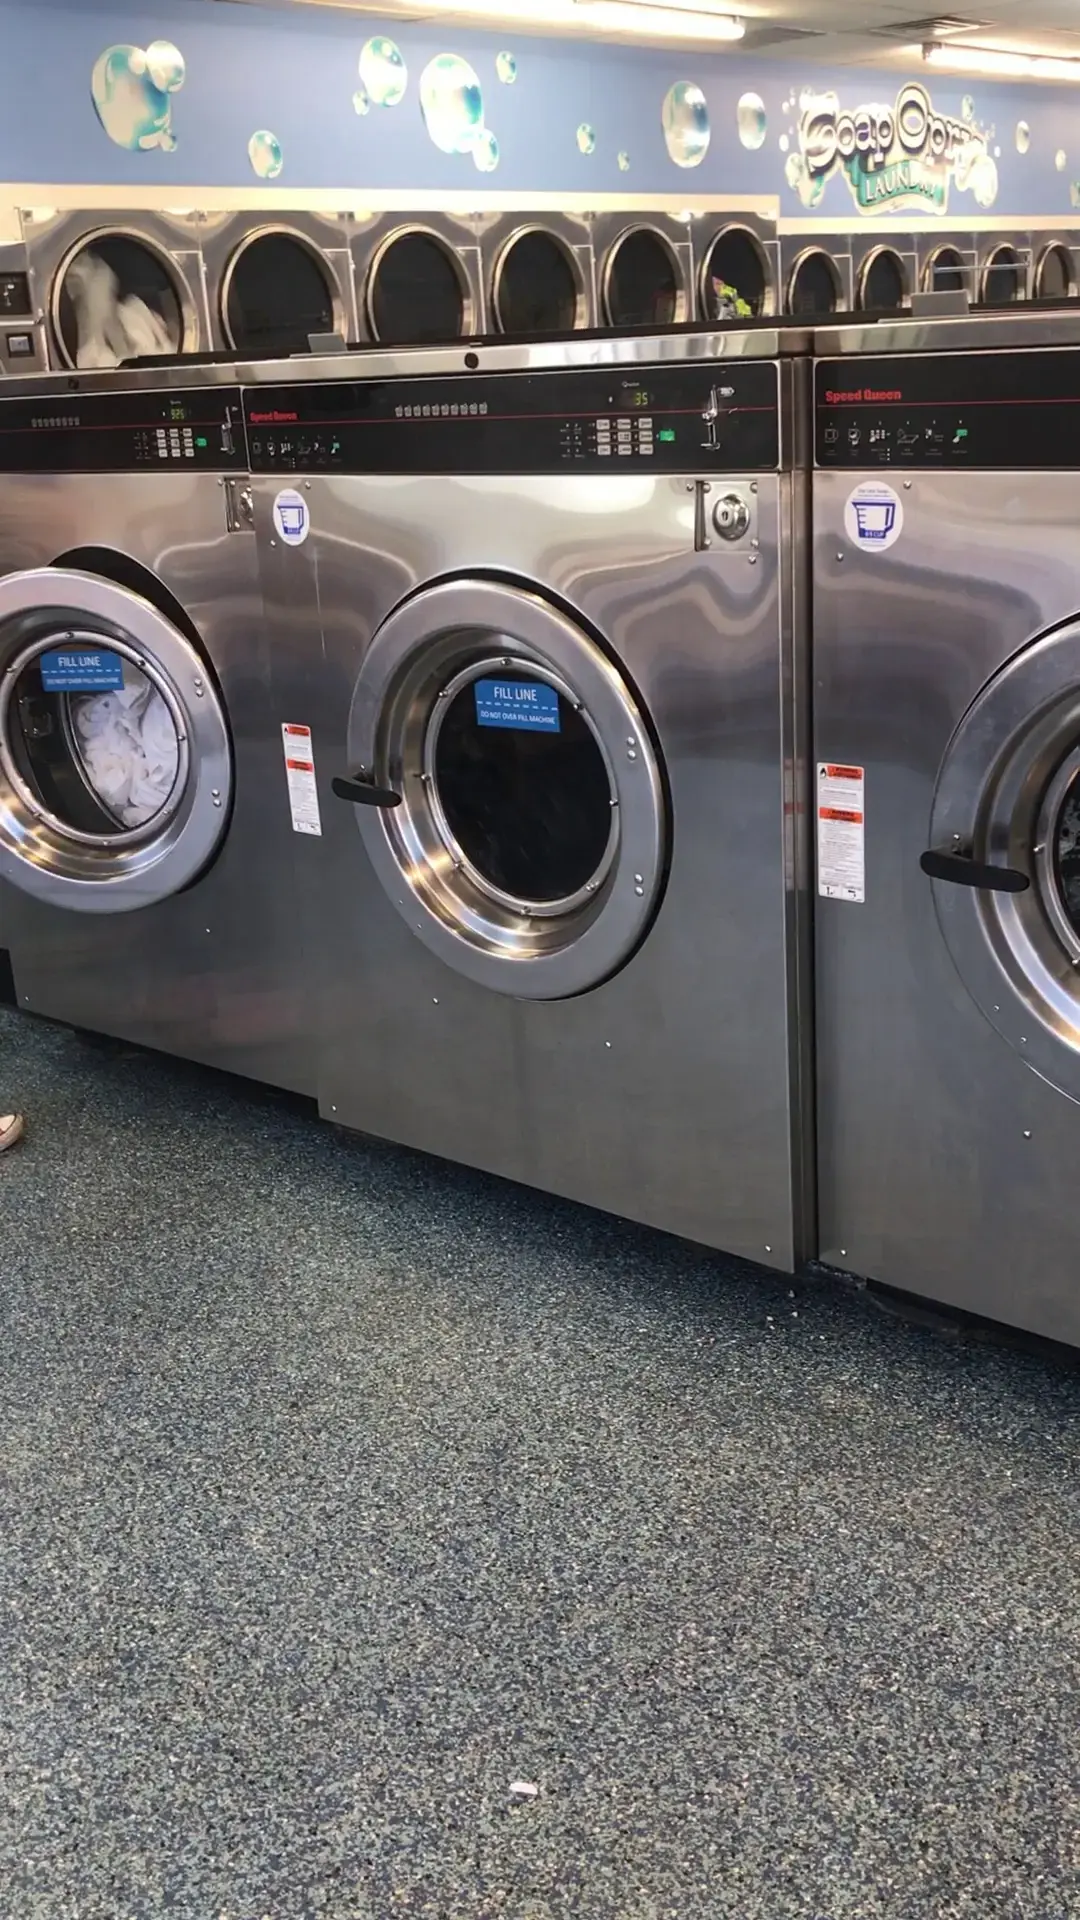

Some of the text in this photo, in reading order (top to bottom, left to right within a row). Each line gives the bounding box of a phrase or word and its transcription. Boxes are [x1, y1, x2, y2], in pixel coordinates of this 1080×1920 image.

[801, 104, 895, 174] Soap
[635, 391, 648, 406] 35
[825, 388, 902, 404] Speed Queen
[57, 656, 101, 667] FILL LINE
[494, 686, 538, 702] FILL LINE
[480, 710, 556, 725] DO NOT OVER FILL MACHINE
